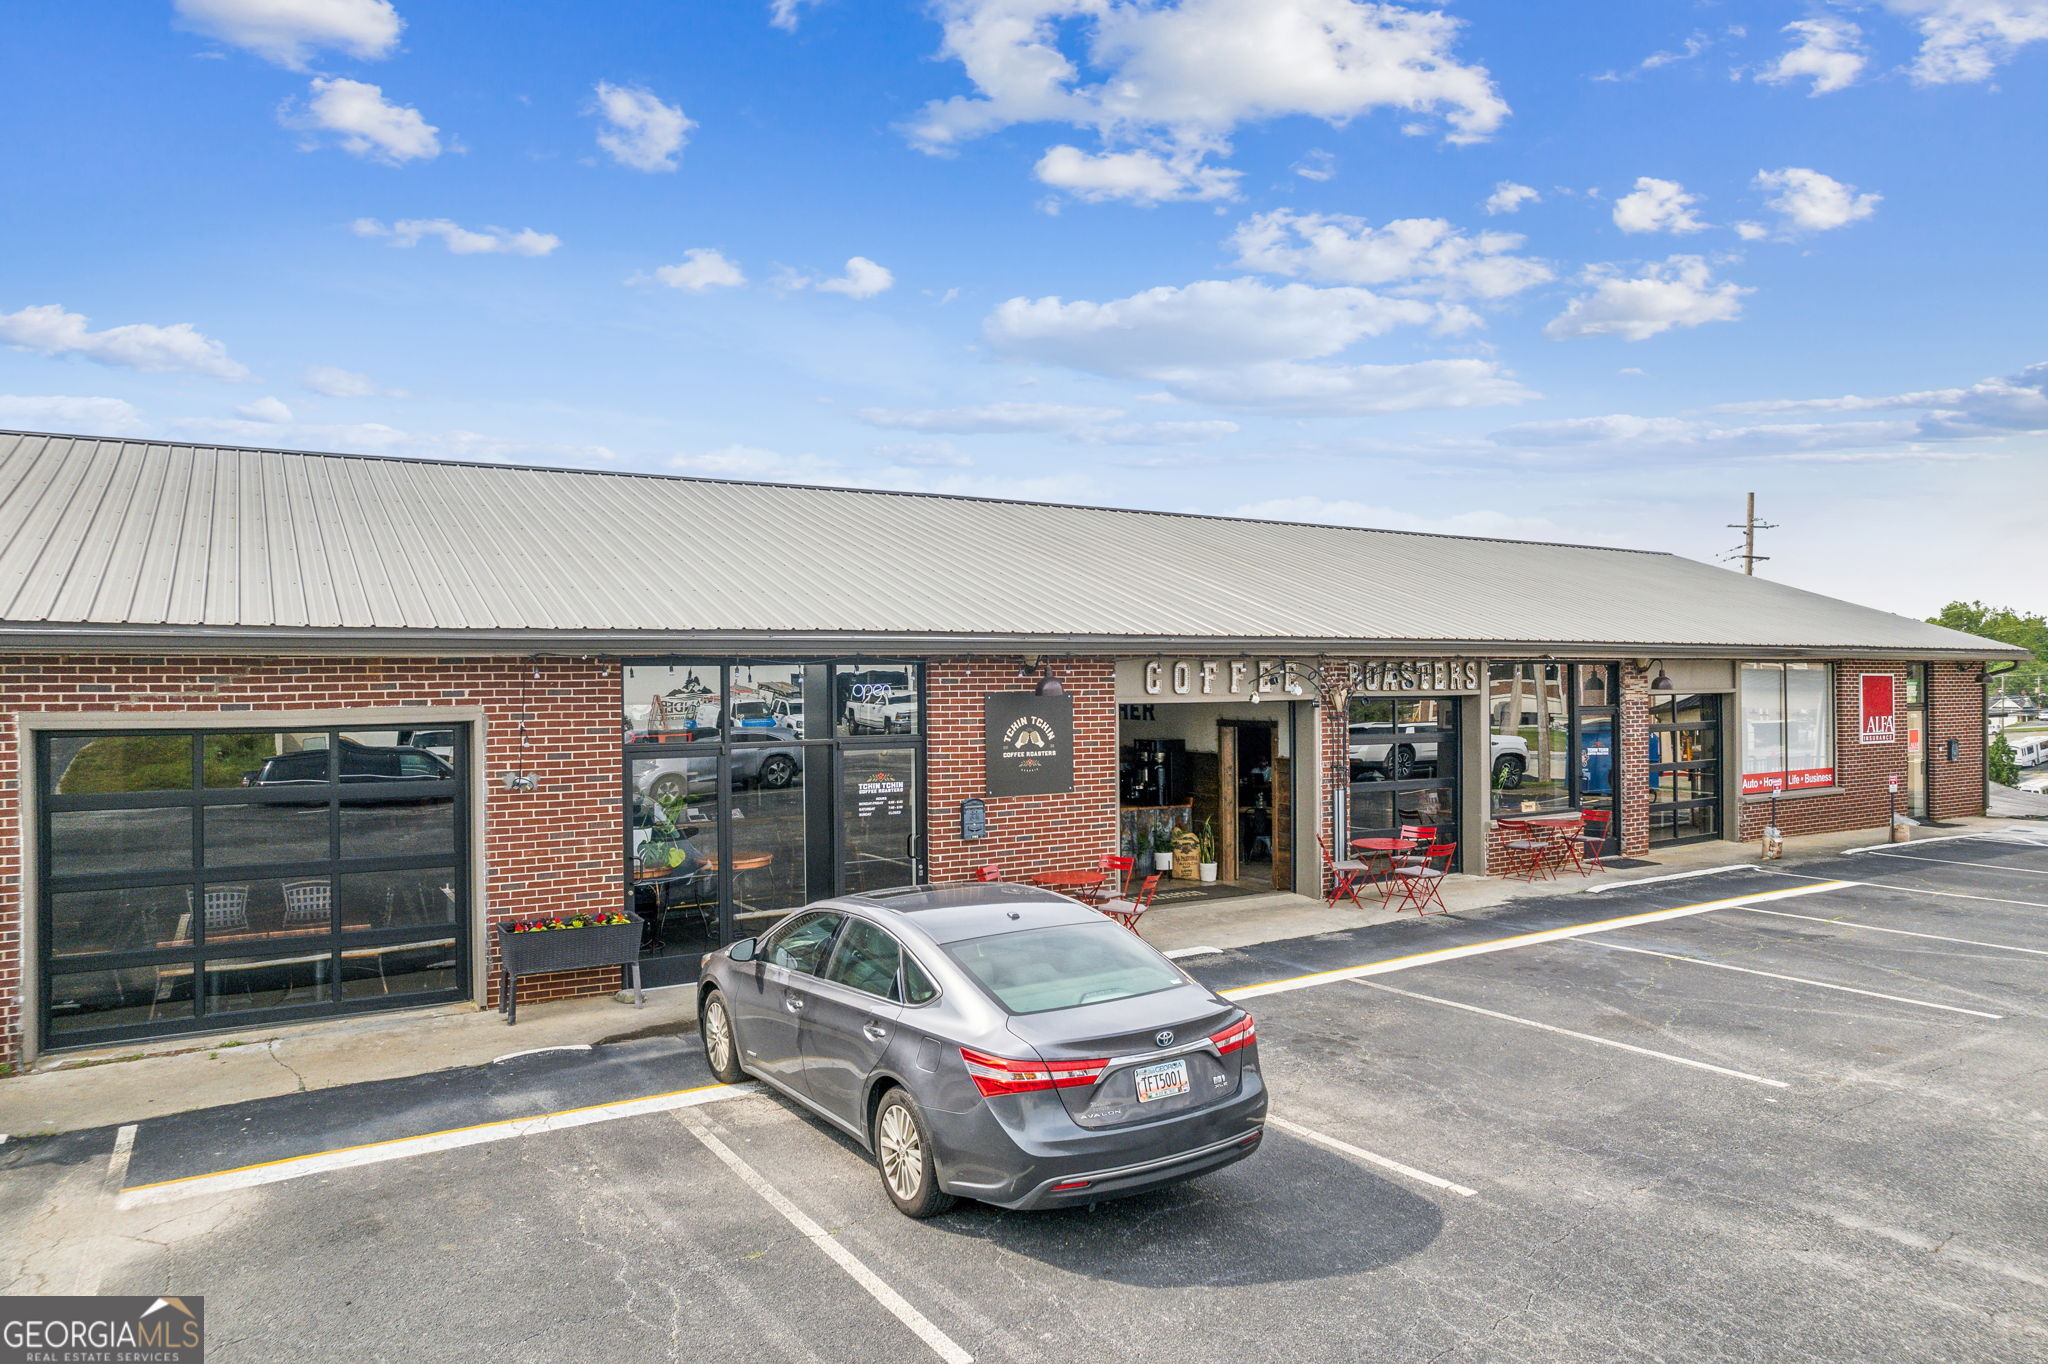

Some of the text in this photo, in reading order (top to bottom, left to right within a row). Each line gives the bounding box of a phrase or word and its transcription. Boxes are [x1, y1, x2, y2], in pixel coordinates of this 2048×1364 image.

[1145, 660, 1477, 695] COFFEE ROASTERS
[853, 684, 892, 702] open
[1003, 716, 1056, 742] TCHIN TCHIN
[1866, 715, 1894, 733] ALFA
[1863, 734, 1893, 742] INSURANCE
[881, 781, 904, 789] TCHIN
[1743, 778, 1759, 789] Auto
[1763, 777, 1783, 787] Hoe
[1788, 774, 1800, 785] Life
[1804, 772, 1832, 784] Business
[1141, 1070, 1182, 1093] TFT5001
[1081, 1109, 1121, 1120] AVALON
